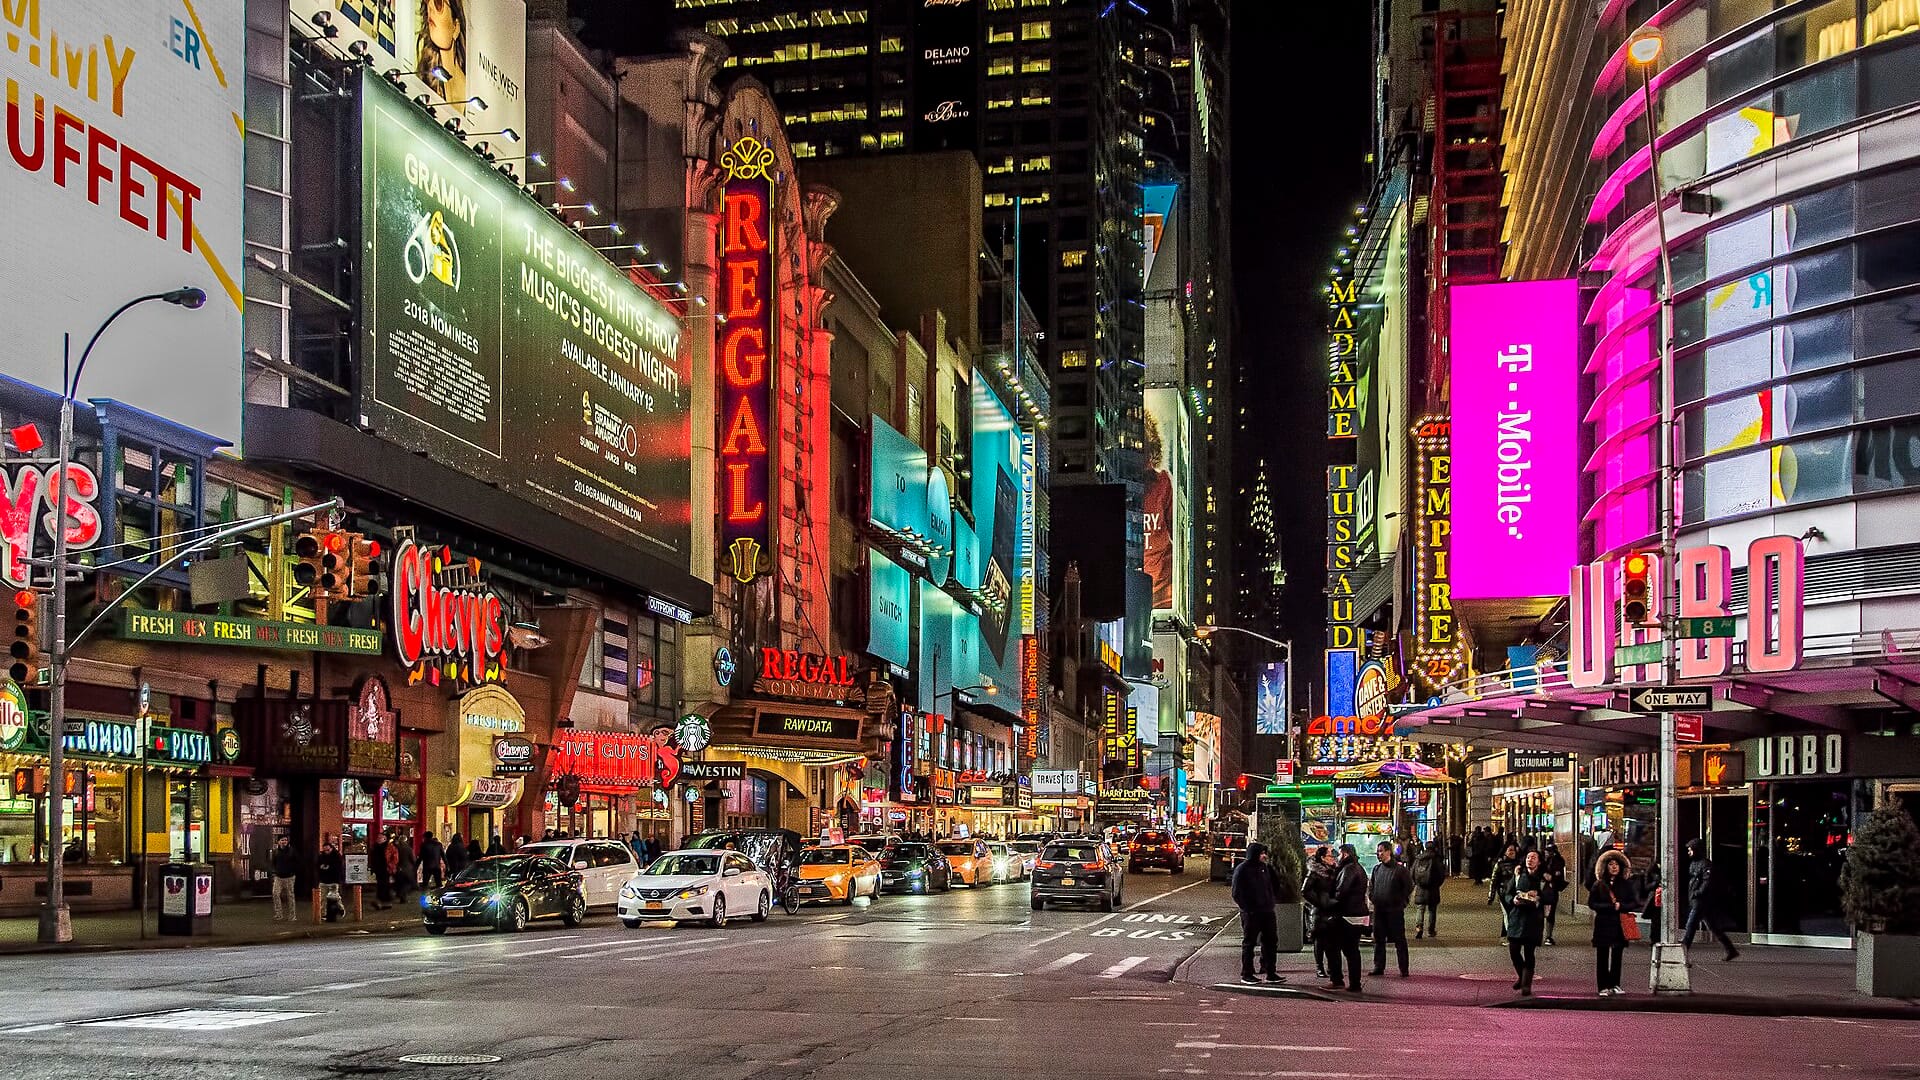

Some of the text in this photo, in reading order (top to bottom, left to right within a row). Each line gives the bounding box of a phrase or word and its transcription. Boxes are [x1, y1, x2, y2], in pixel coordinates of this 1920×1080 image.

[925, 46, 970, 60] DELANO
[478, 51, 520, 101] NINE WEST
[405, 153, 479, 228] GRAMMY
[524, 222, 679, 362] THE BIGGEST HITS FROM
[404, 298, 429, 326] 2018
[430, 313, 479, 355] NOMINEES
[521, 261, 581, 329] MUSIC'S
[583, 305, 638, 369] BIGGEST
[722, 192, 767, 521] REGAL
[1330, 279, 1357, 436] MADAME
[561, 338, 609, 383] AVAILABLE
[608, 373, 646, 407] JANUARY
[594, 410, 621, 436] GRAMMY
[594, 425, 619, 449] AWARDS
[895, 472, 906, 494] TO
[930, 512, 948, 539] ENJOY
[1426, 455, 1452, 644] EMPIRE
[393, 538, 503, 685] Chevys
[648, 599, 676, 617] OUTFRONT
[879, 595, 903, 624] SWITCH
[132, 615, 174, 635] FRESH
[181, 619, 207, 637] MEX
[214, 621, 251, 640] FRESH
[255, 625, 280, 642] MEX
[286, 629, 319, 645] FRESH
[349, 633, 379, 650] FRESH
[1703, 620, 1713, 635] 8
[960, 639, 968, 655] TO
[761, 647, 855, 686] REGAL
[1428, 660, 1451, 677] 25
[770, 681, 846, 699] CINEMAS
[1359, 677, 1380, 707] DAVE
[1644, 692, 1702, 706] ONE WAY
[1107, 692, 1117, 734] VICTORY
[1307, 715, 1381, 735] amc
[171, 731, 212, 762] PASTA
[497, 740, 530, 760] Chevys
[601, 743, 650, 761] GUYS
[1758, 734, 1842, 776] URBO
[693, 764, 742, 777] WESTIN
[1037, 774, 1074, 785] TRAVESIES
[1624, 752, 1659, 785] SQUA
[1099, 788, 1150, 798] HARRY POTTER
[1122, 913, 1223, 924] ONLY
[1090, 927, 1194, 941] BUS
